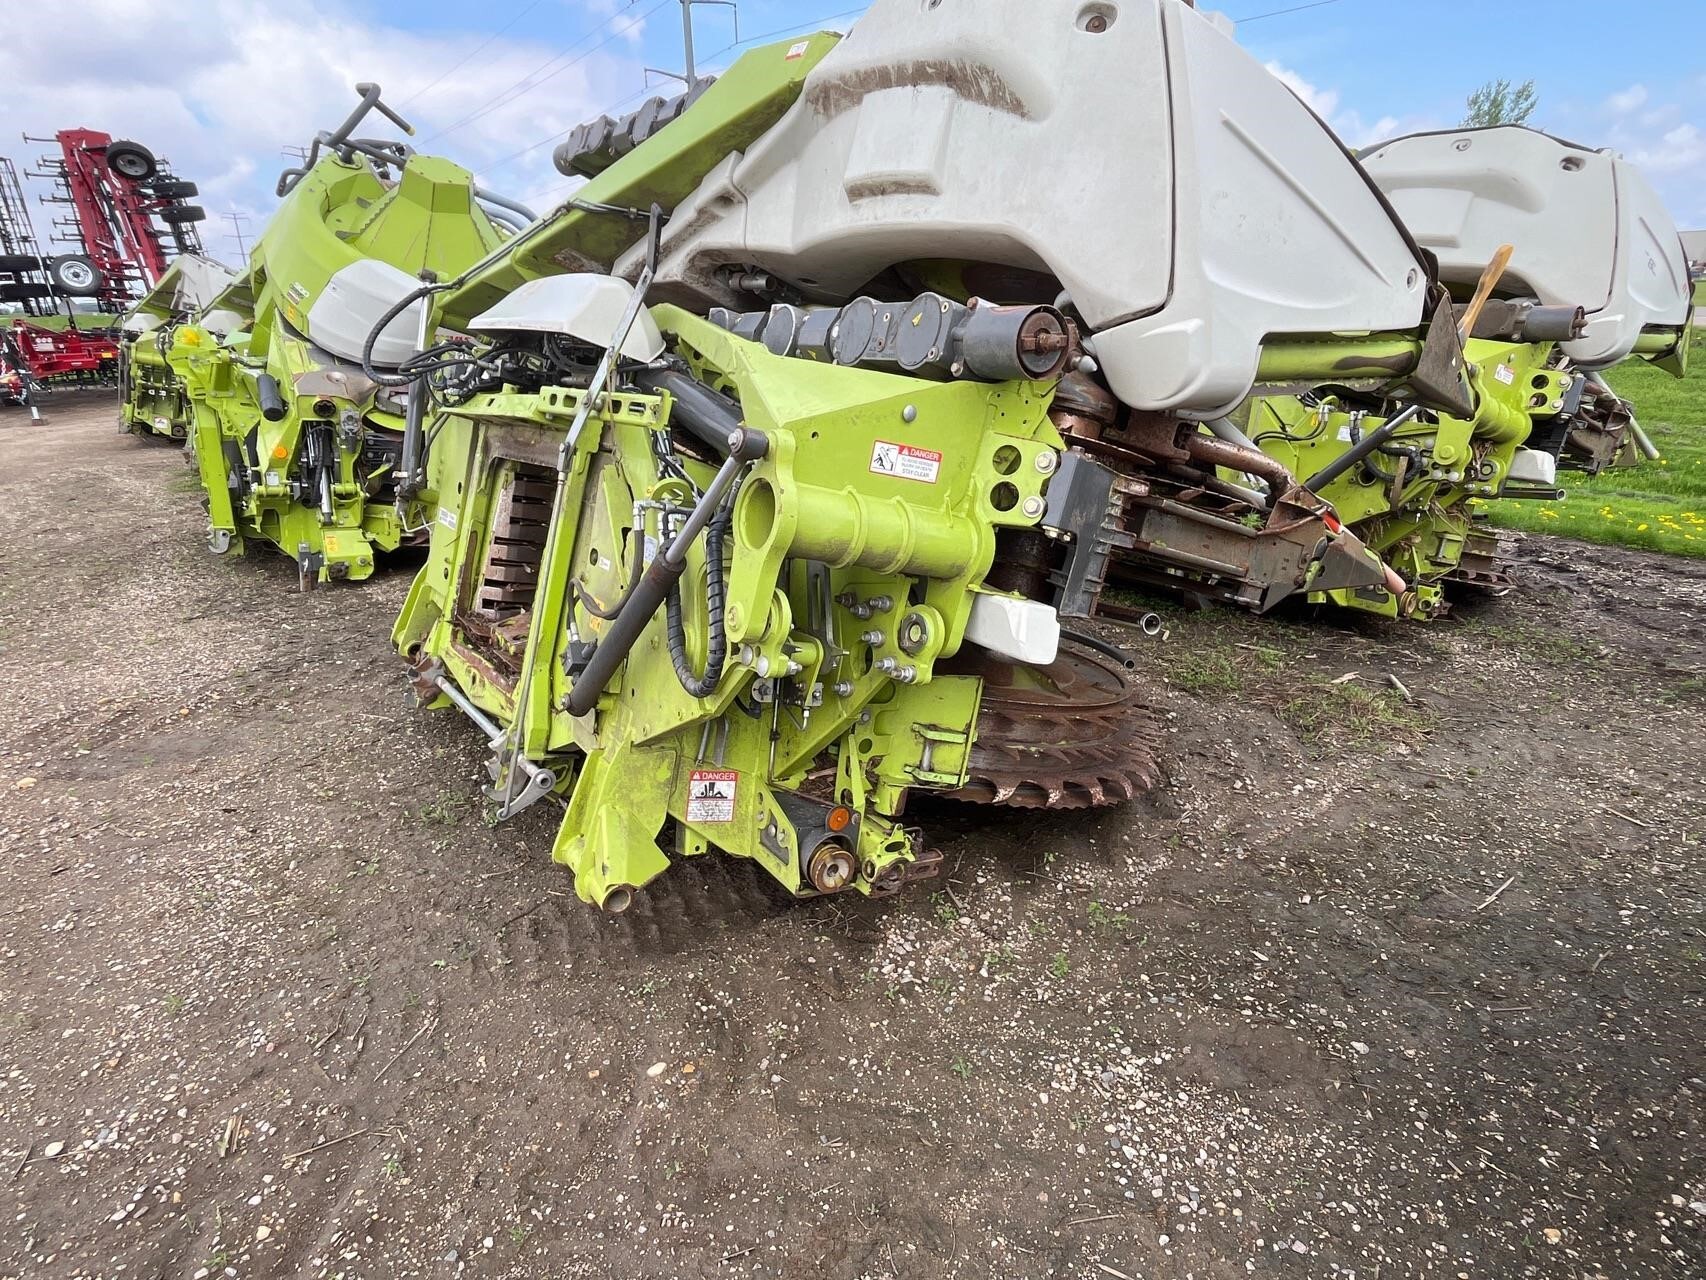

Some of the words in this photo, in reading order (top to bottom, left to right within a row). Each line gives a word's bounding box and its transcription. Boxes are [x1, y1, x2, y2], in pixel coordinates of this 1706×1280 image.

[911, 449, 939, 460] DANGER
[914, 470, 930, 478] CLEAR
[702, 772, 735, 780] DANGER
